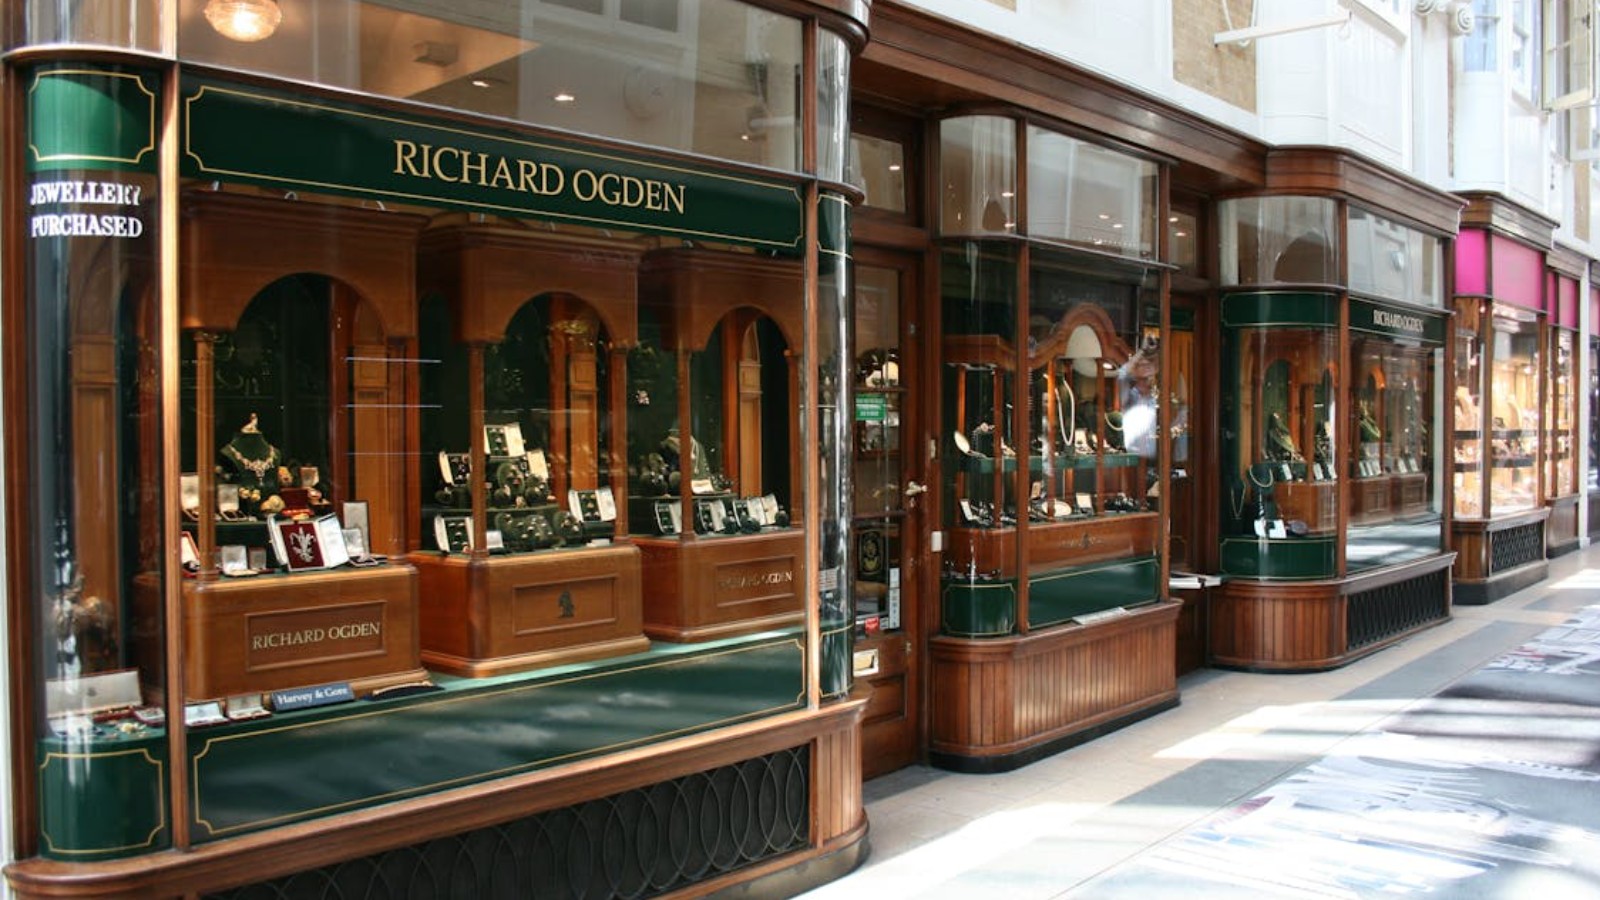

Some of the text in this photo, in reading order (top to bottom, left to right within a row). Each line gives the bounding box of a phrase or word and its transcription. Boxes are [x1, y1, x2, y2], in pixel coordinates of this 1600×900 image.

[393, 139, 687, 215] RICHARD OGDEN
[31, 213, 143, 238] PURCHASED
[252, 621, 381, 650] RICHARD OGDEN
[276, 691, 314, 705] Harvey
[314, 688, 324, 699] &
